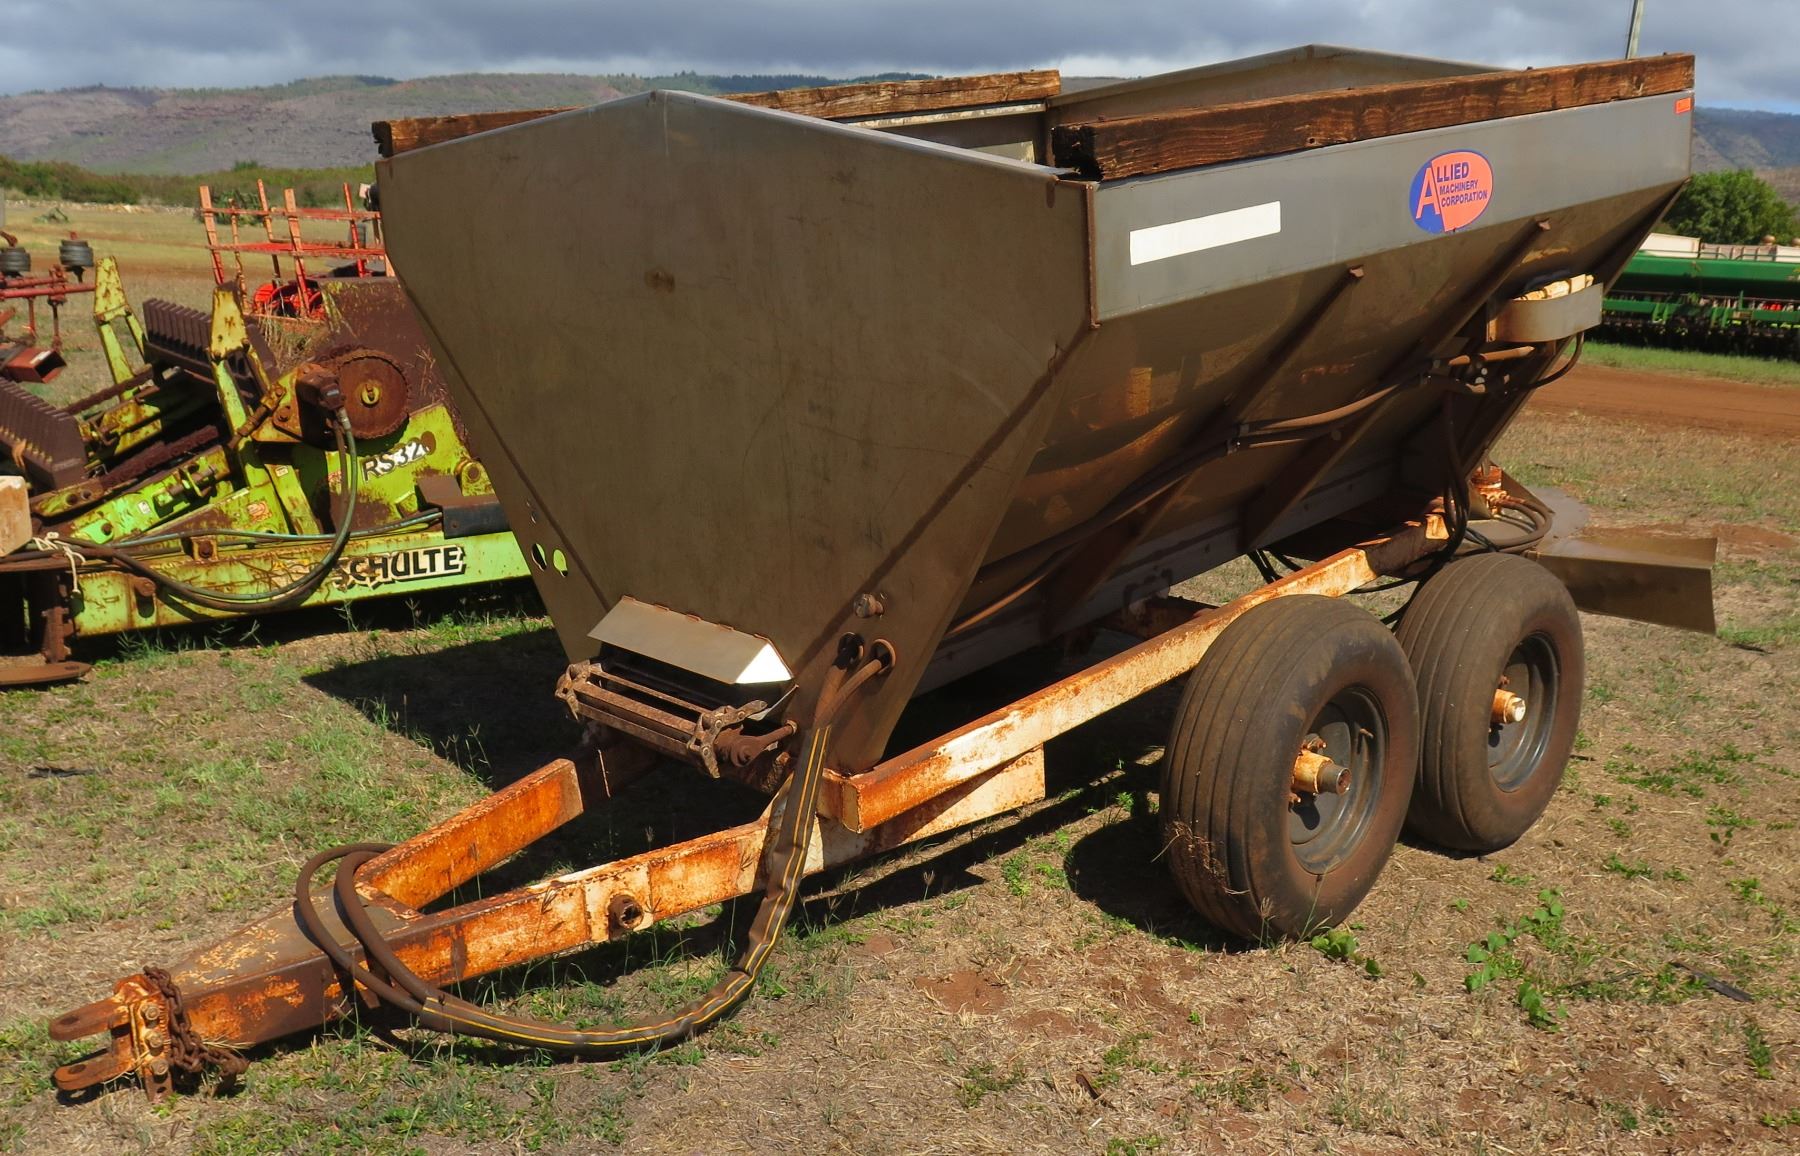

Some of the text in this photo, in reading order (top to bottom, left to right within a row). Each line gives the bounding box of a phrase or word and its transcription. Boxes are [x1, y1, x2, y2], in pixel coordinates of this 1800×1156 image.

[1415, 161, 1470, 219] ALLIED
[1439, 180, 1479, 195] MACHINERY
[1441, 190, 1488, 207] CORPORATION
[362, 441, 432, 482] RS32
[332, 546, 464, 590] SCHULTE
